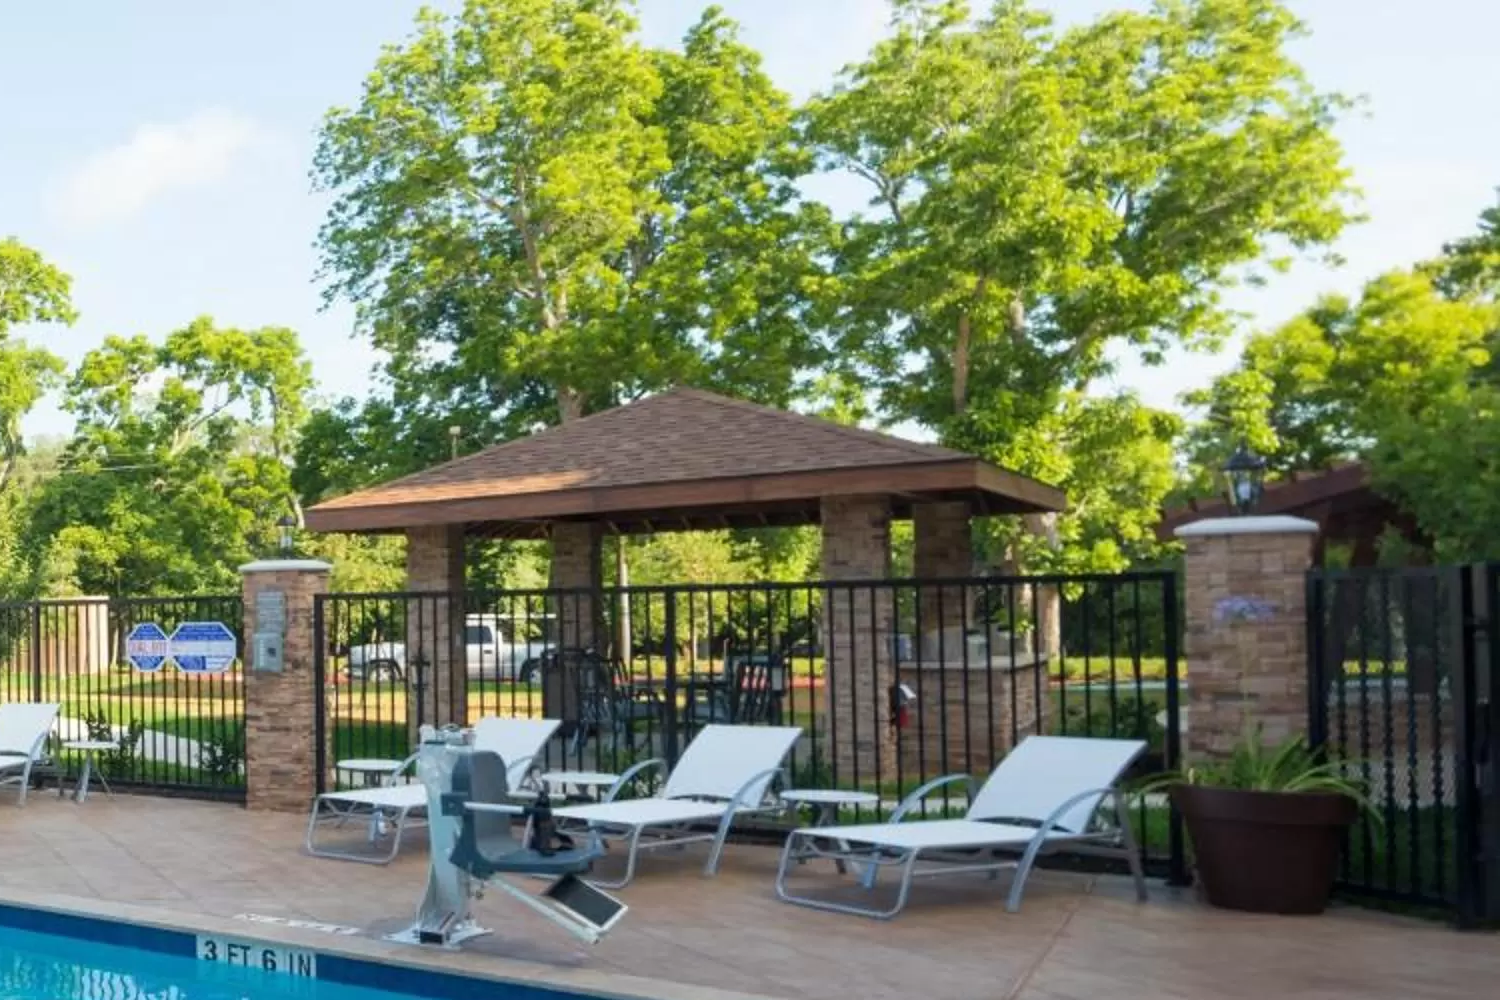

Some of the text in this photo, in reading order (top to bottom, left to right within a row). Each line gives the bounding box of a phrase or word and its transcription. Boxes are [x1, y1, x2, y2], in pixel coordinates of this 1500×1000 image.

[204, 940, 311, 976] 3 FT 6 IN
